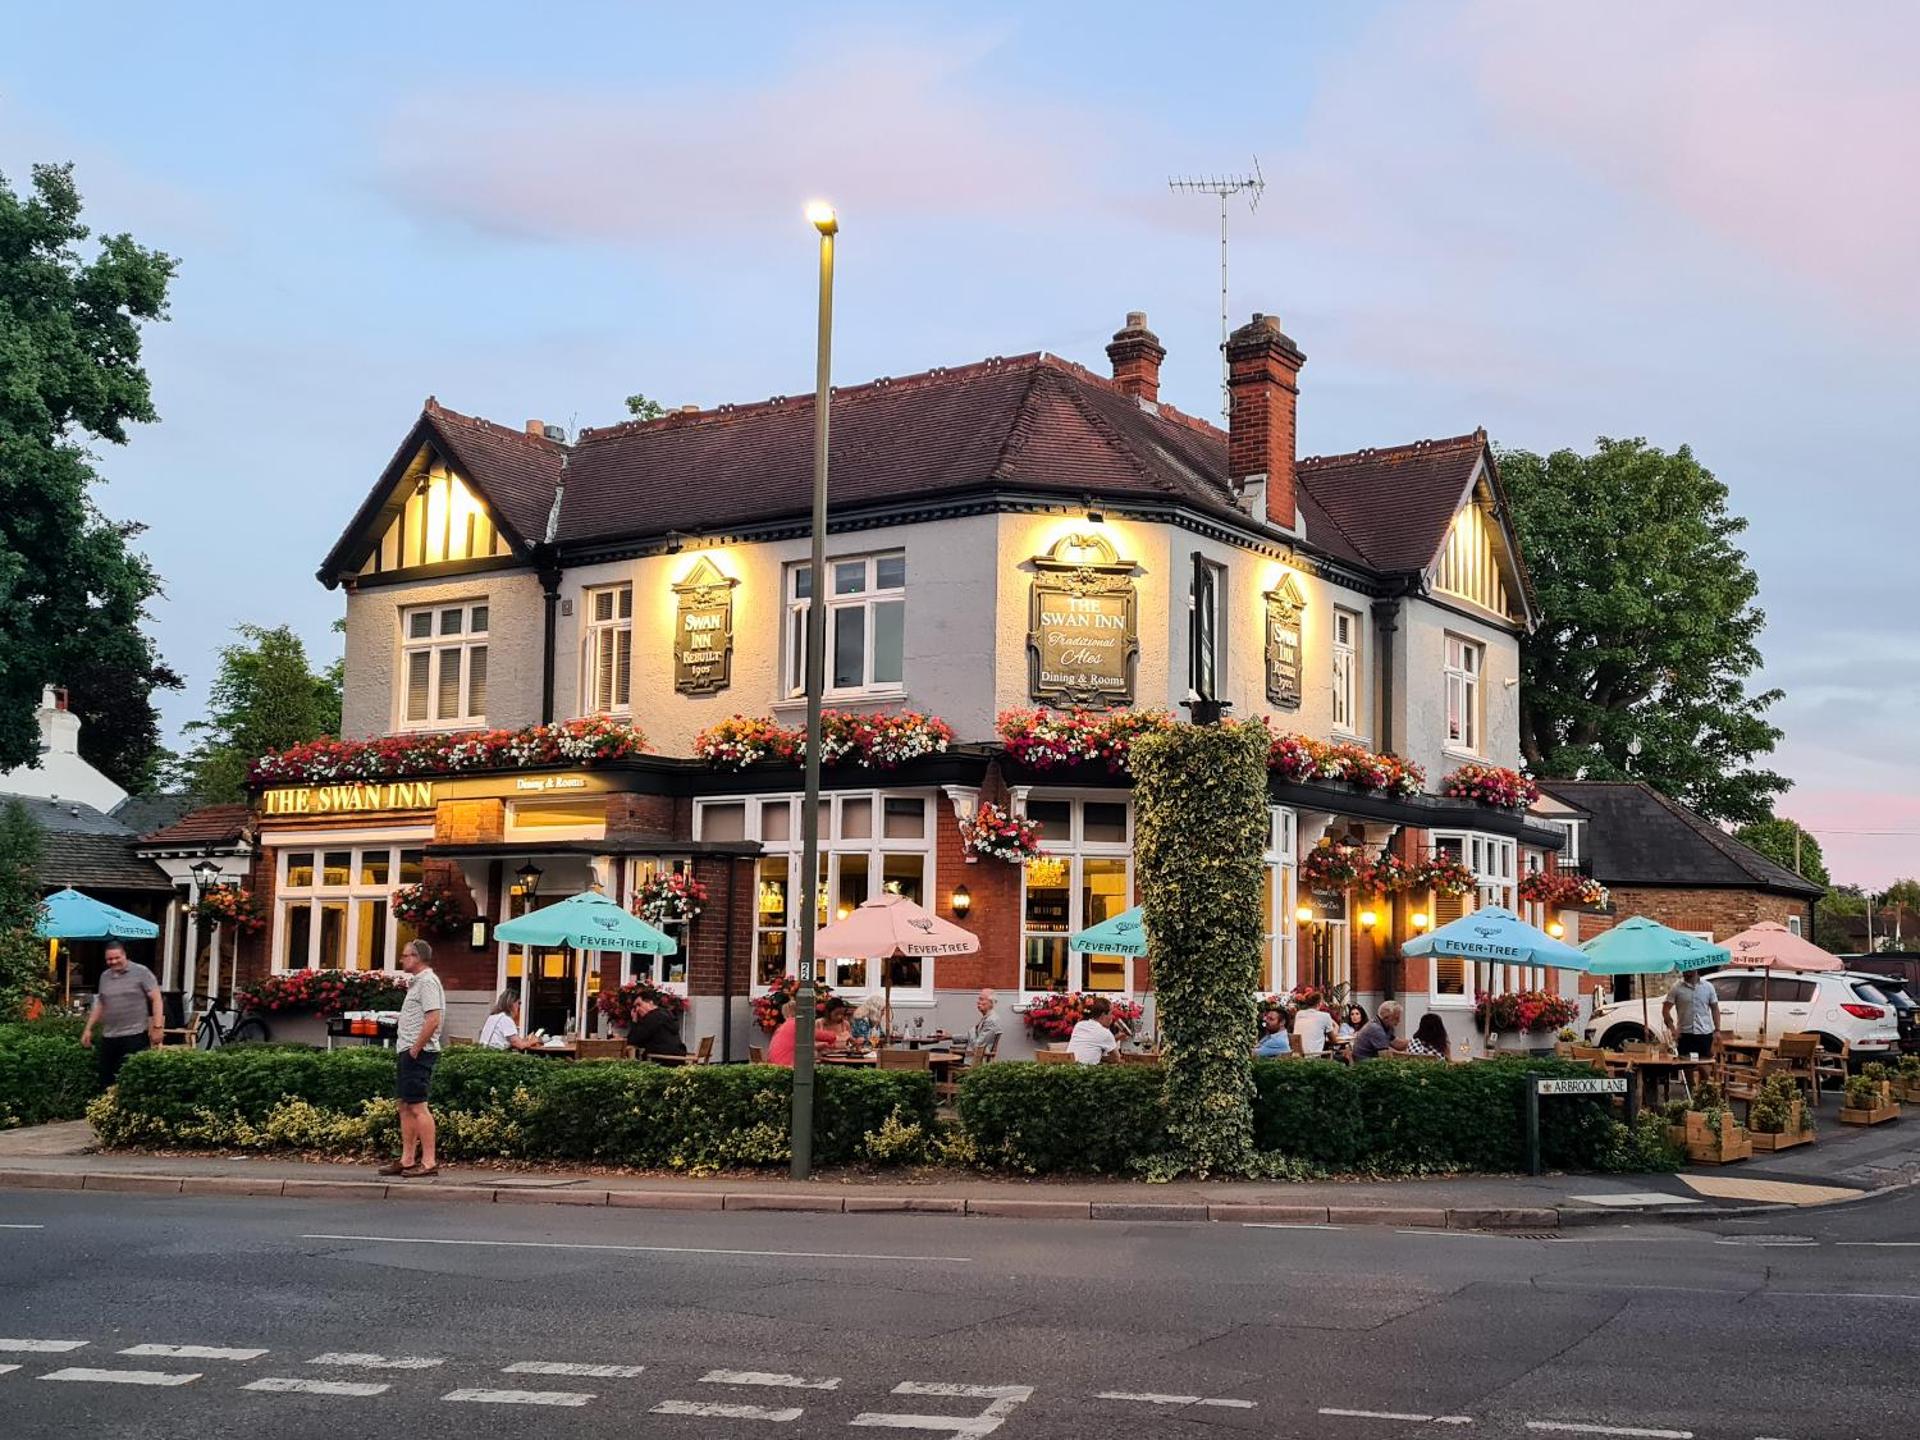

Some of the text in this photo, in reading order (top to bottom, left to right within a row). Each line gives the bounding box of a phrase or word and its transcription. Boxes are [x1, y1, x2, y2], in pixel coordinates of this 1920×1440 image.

[1068, 597, 1101, 613] THE
[684, 614, 721, 632] SWAN
[1041, 612, 1125, 630] SWAN INN
[691, 632, 712, 650] INN
[1047, 631, 1116, 647] Traditional
[1060, 648, 1105, 665] Ales
[1041, 671, 1125, 686] Dining & Rooms
[263, 781, 434, 815] THE SWAN INN
[580, 935, 649, 949] FEVER-TREE
[907, 943, 970, 954] FEVER-TREE
[1077, 940, 1141, 954] FEVER-TREE
[1445, 940, 1520, 957] FEVER-TREE
[1682, 953, 1725, 969] FEVER-TREE
[1553, 1079, 1625, 1093] ARBROOK LANE
